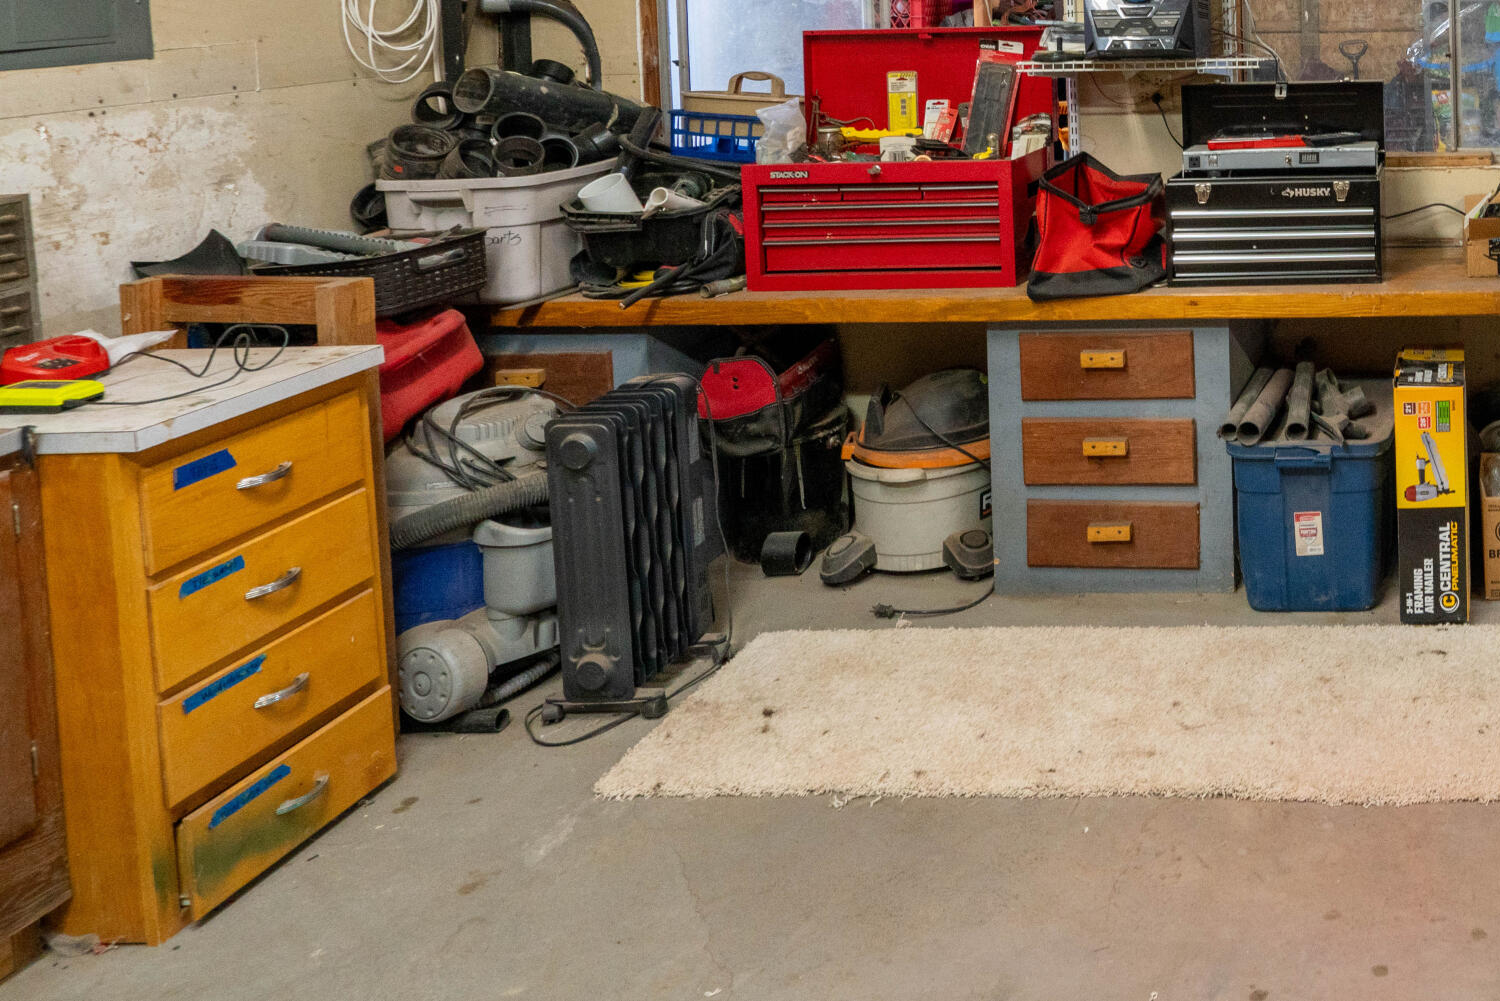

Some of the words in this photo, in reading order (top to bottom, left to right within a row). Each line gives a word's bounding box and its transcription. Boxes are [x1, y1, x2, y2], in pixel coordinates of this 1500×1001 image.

[769, 171, 809, 179] STACK-ON
[1294, 187, 1331, 197] HUSKY
[1438, 521, 1452, 592] CENTRAL
[1451, 520, 1459, 591] PNEUMATIC
[1413, 567, 1424, 615] FRAMING
[1423, 557, 1434, 594] NAILER
[1424, 595, 1435, 614] AIR
